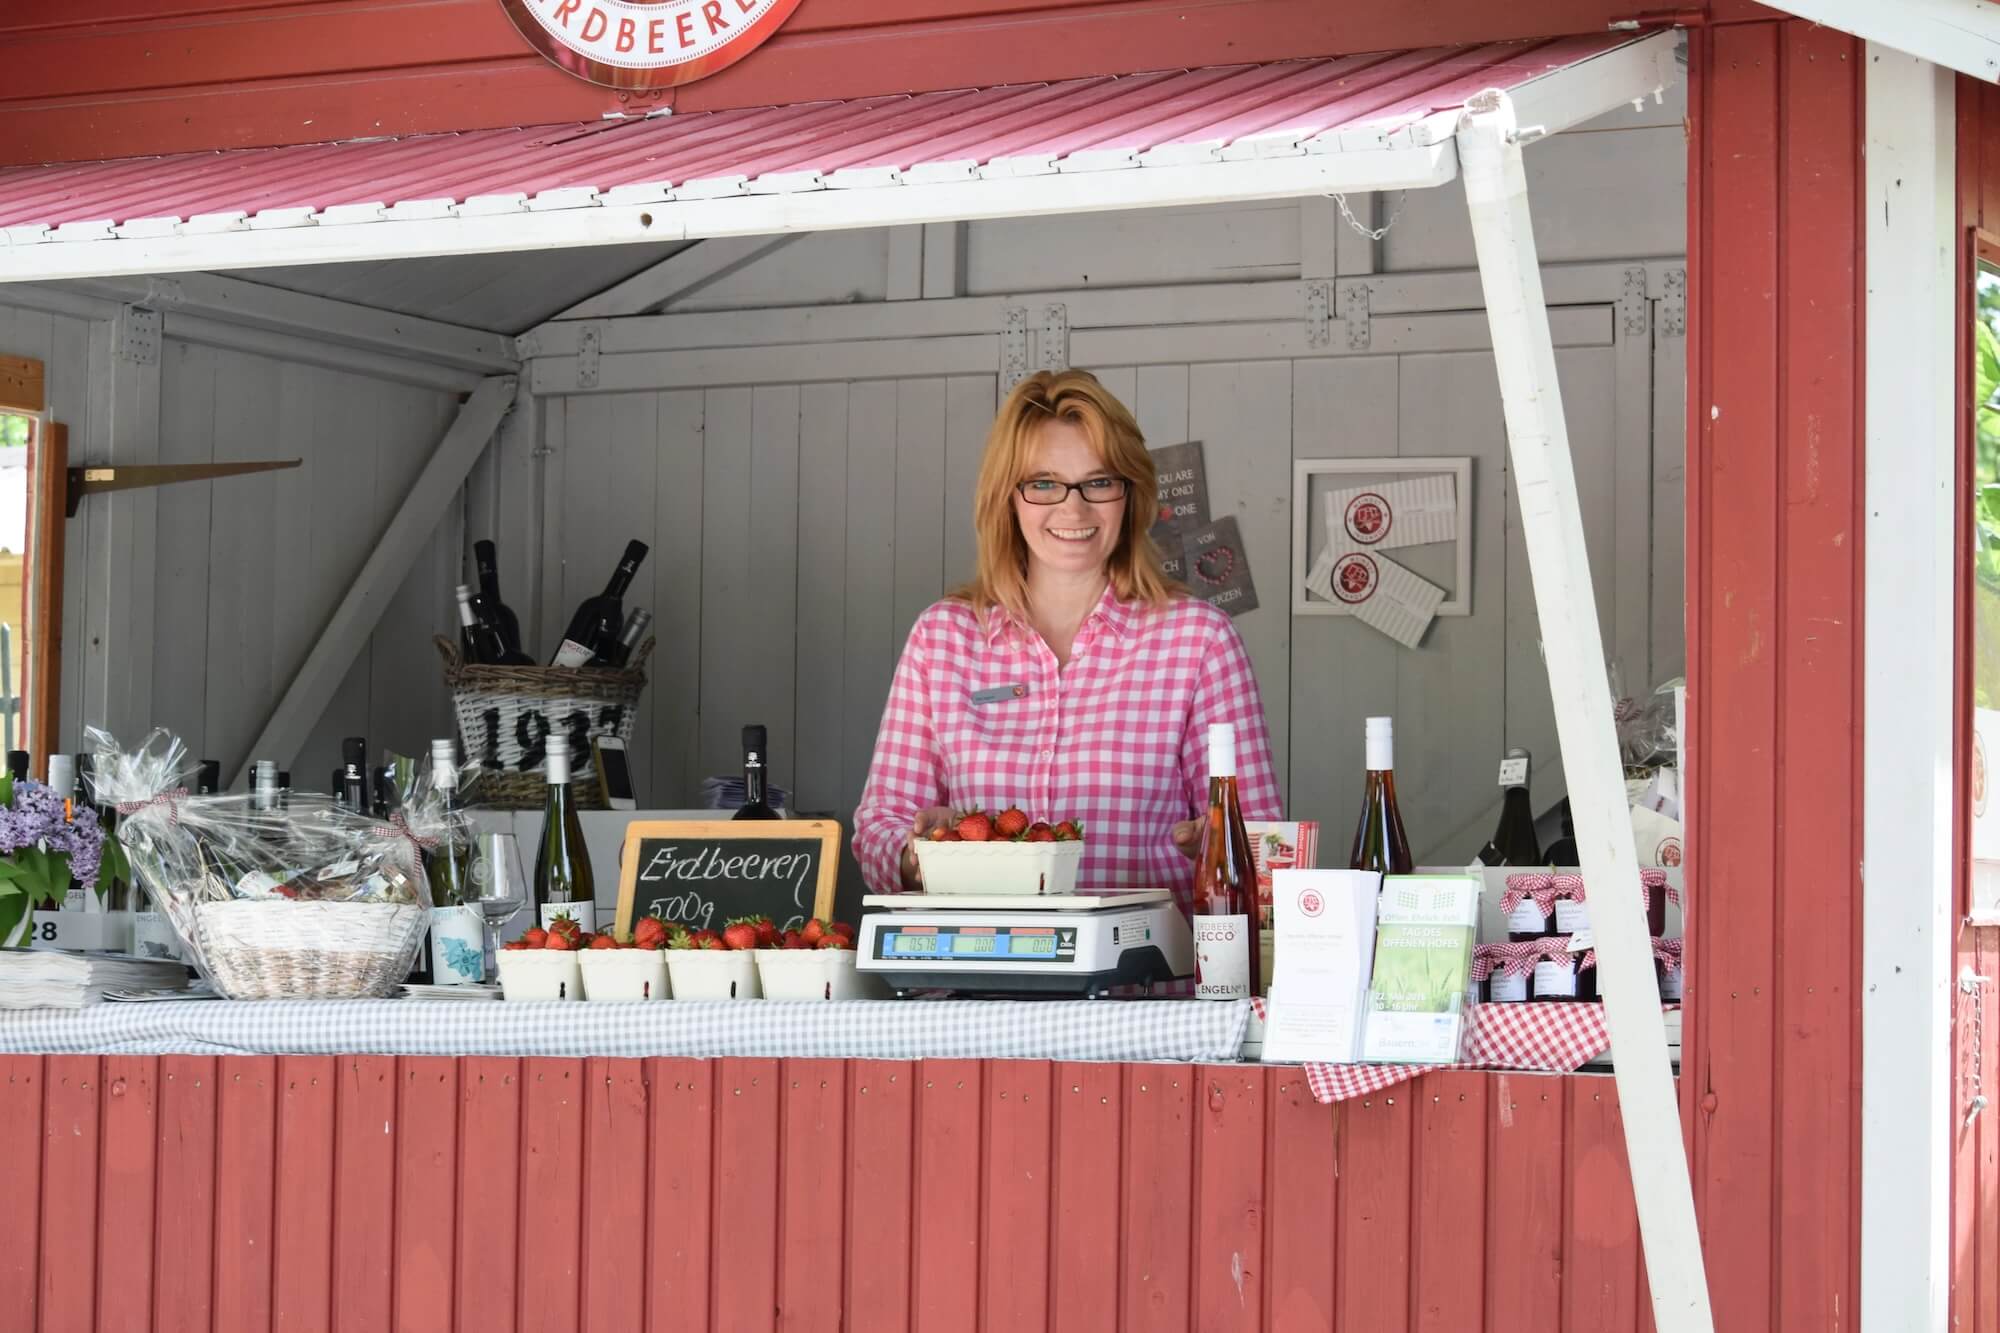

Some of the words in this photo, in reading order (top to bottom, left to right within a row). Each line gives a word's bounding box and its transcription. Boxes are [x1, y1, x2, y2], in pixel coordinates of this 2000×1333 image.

[537, 0, 758, 54] RDBEER
[1158, 472, 1172, 484] OU
[1175, 469, 1194, 481] ARE
[1171, 484, 1194, 497] ONLY
[1174, 503, 1198, 516] ONE
[1196, 530, 1217, 545] VON
[1160, 559, 1179, 573] CH
[640, 845, 812, 908] Erdbeeren
[649, 891, 715, 930] 500g
[1197, 931, 1235, 942] SECCO
